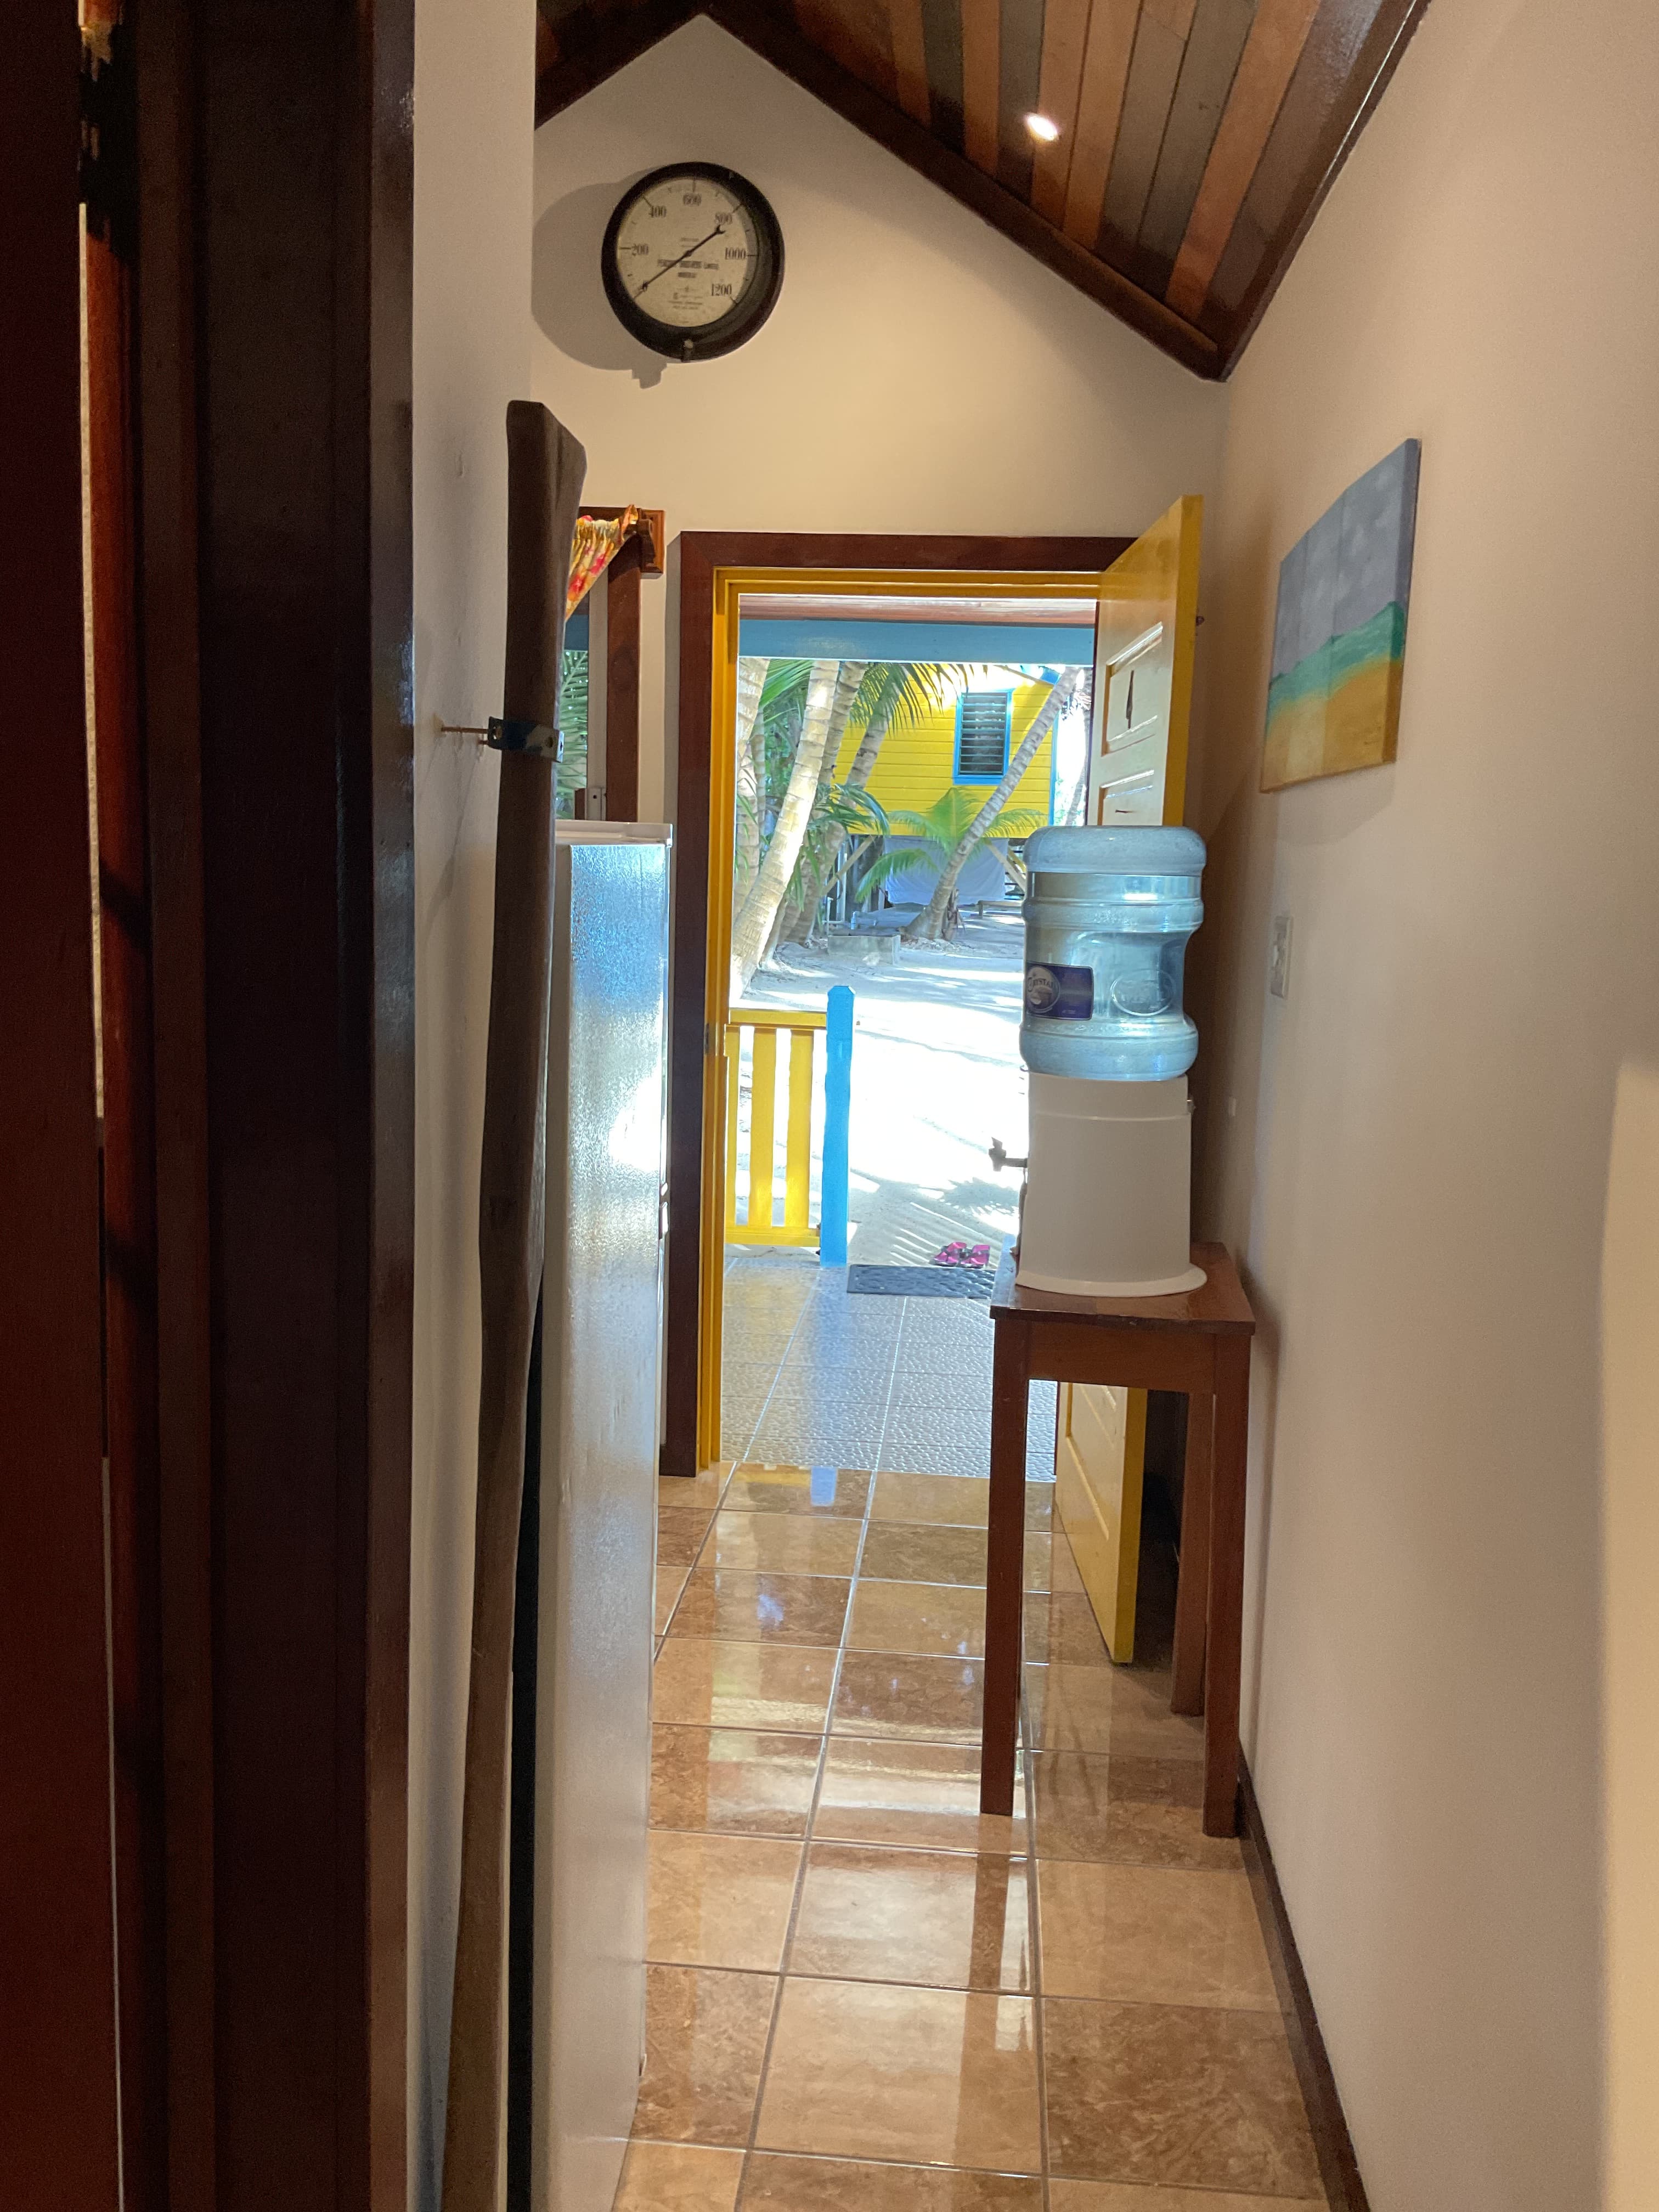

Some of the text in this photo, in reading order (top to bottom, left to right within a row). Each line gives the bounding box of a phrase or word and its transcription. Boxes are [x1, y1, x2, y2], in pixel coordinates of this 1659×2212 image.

[648, 206, 667, 218] 400
[715, 212, 733, 225] 800
[632, 244, 649, 256] 200
[725, 247, 747, 261] 1000
[711, 283, 732, 297] 1200
